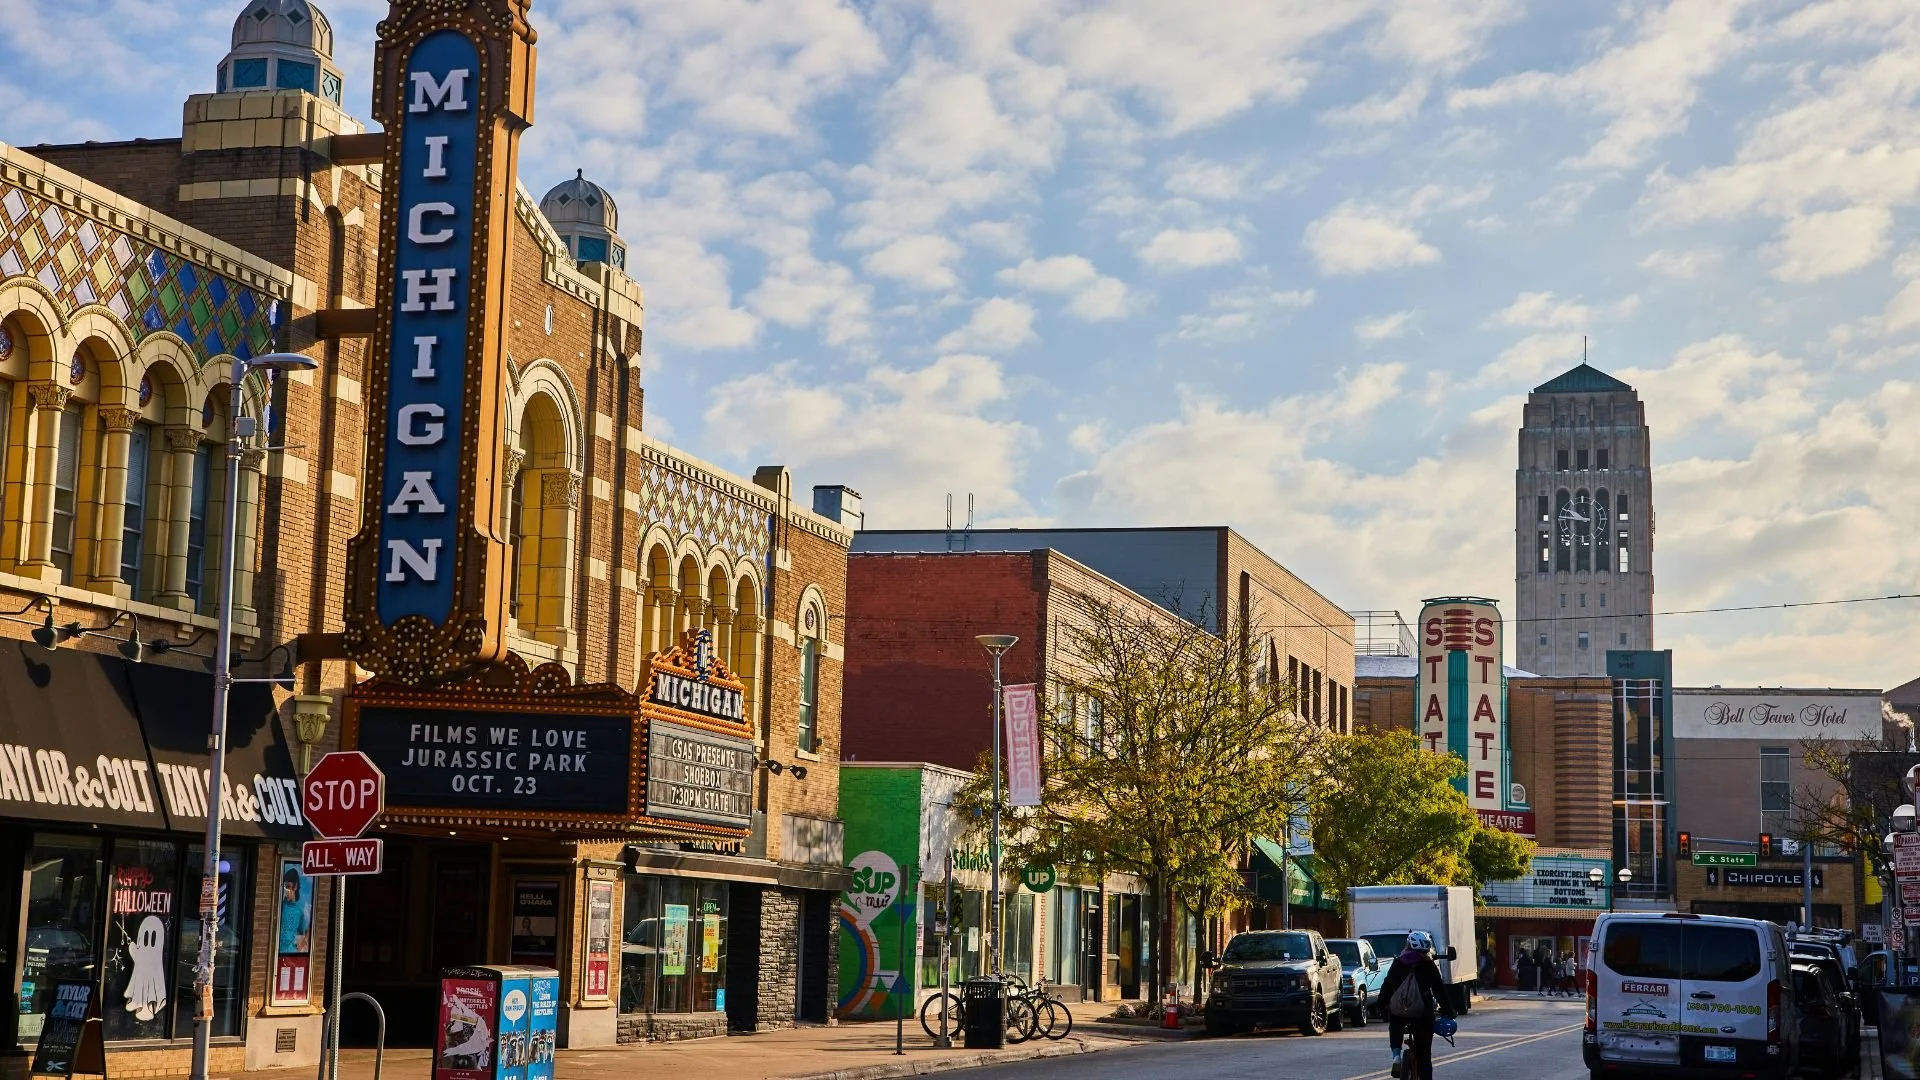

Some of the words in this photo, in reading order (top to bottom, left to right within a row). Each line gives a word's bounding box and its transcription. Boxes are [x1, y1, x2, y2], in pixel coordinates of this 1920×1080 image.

[386, 68, 469, 583] MICHIGAN
[657, 673, 744, 720] MICHIGAN
[1424, 617, 1444, 753] STAT
[1473, 617, 1496, 800] STATE
[1703, 701, 1744, 726] Bell
[1749, 703, 1796, 726] Tower
[1800, 703, 1848, 728] Hotel
[410, 724, 477, 745] FILMS
[490, 727, 519, 746] WE
[531, 729, 587, 748] LOVE
[401, 748, 517, 770] JURASSIC
[528, 752, 587, 772] PARK
[672, 739, 694, 762] CSAS
[696, 744, 735, 768] PRESENTS
[452, 774, 502, 793] OCT.
[513, 776, 537, 795] 23
[684, 765, 721, 788] SHOEBOX
[308, 779, 376, 812] STOP
[671, 786, 700, 808] 7:30PM
[704, 791, 729, 813] STATE
[306, 849, 334, 868] ALL
[345, 846, 375, 866] WAY
[1720, 856, 1745, 864] State
[1028, 871, 1050, 885] UP
[1539, 879, 1571, 887] HAUNTING
[1728, 872, 1802, 885] CHIPOTLE
[113, 889, 171, 914] HALLOWEEN
[1549, 897, 1568, 905] DUMB
[1570, 897, 1593, 905] MONEY
[1554, 888, 1585, 896] BOTTOMS
[57, 983, 91, 1002] TAYLOR
[1624, 983, 1666, 993] FERRARI
